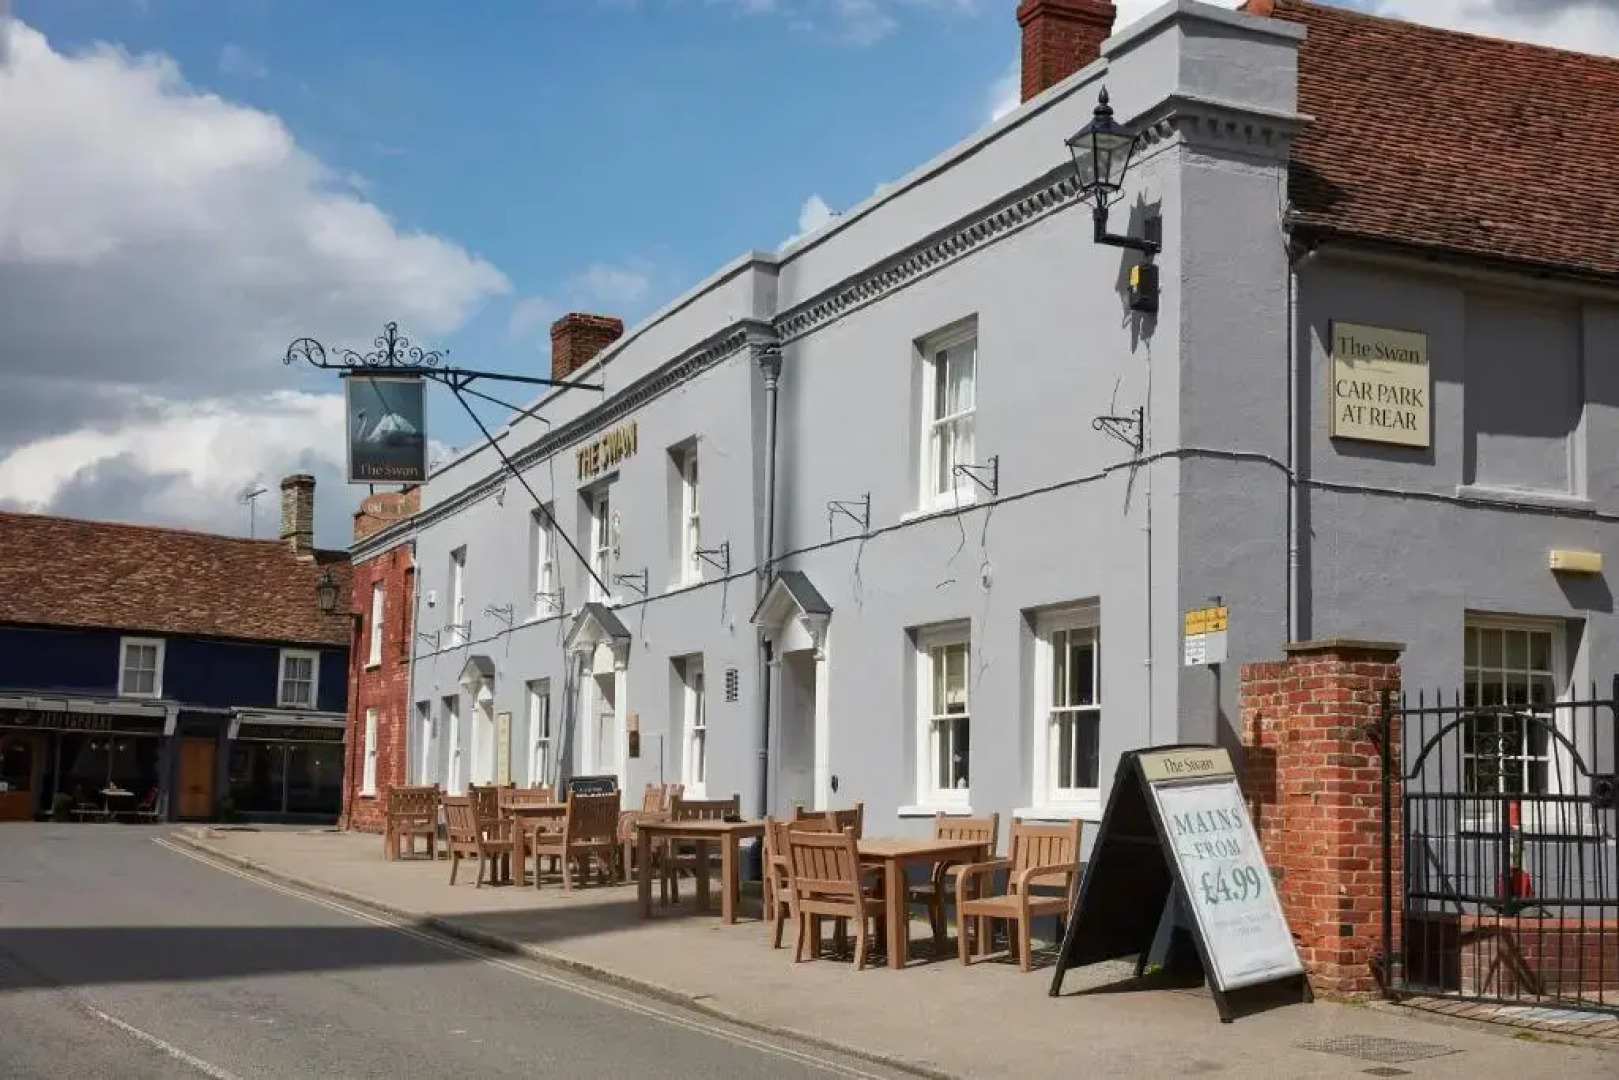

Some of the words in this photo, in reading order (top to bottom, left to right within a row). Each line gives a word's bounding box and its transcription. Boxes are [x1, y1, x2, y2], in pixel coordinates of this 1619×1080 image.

[1337, 336, 1371, 357] The
[1375, 341, 1419, 364] Swan
[1336, 379, 1373, 401] CAR
[1378, 383, 1424, 408] PARK
[1342, 404, 1367, 425] AT
[1370, 407, 1418, 431] REAR
[576, 442, 600, 480] THE
[600, 420, 638, 471] SWAN
[359, 463, 383, 476] The
[385, 466, 419, 477] Swan
[1162, 758, 1184, 773] The
[1183, 757, 1214, 772] Swan
[1174, 807, 1244, 836] MAINS
[1194, 837, 1241, 860] FROM
[1200, 865, 1261, 905] £4.99
